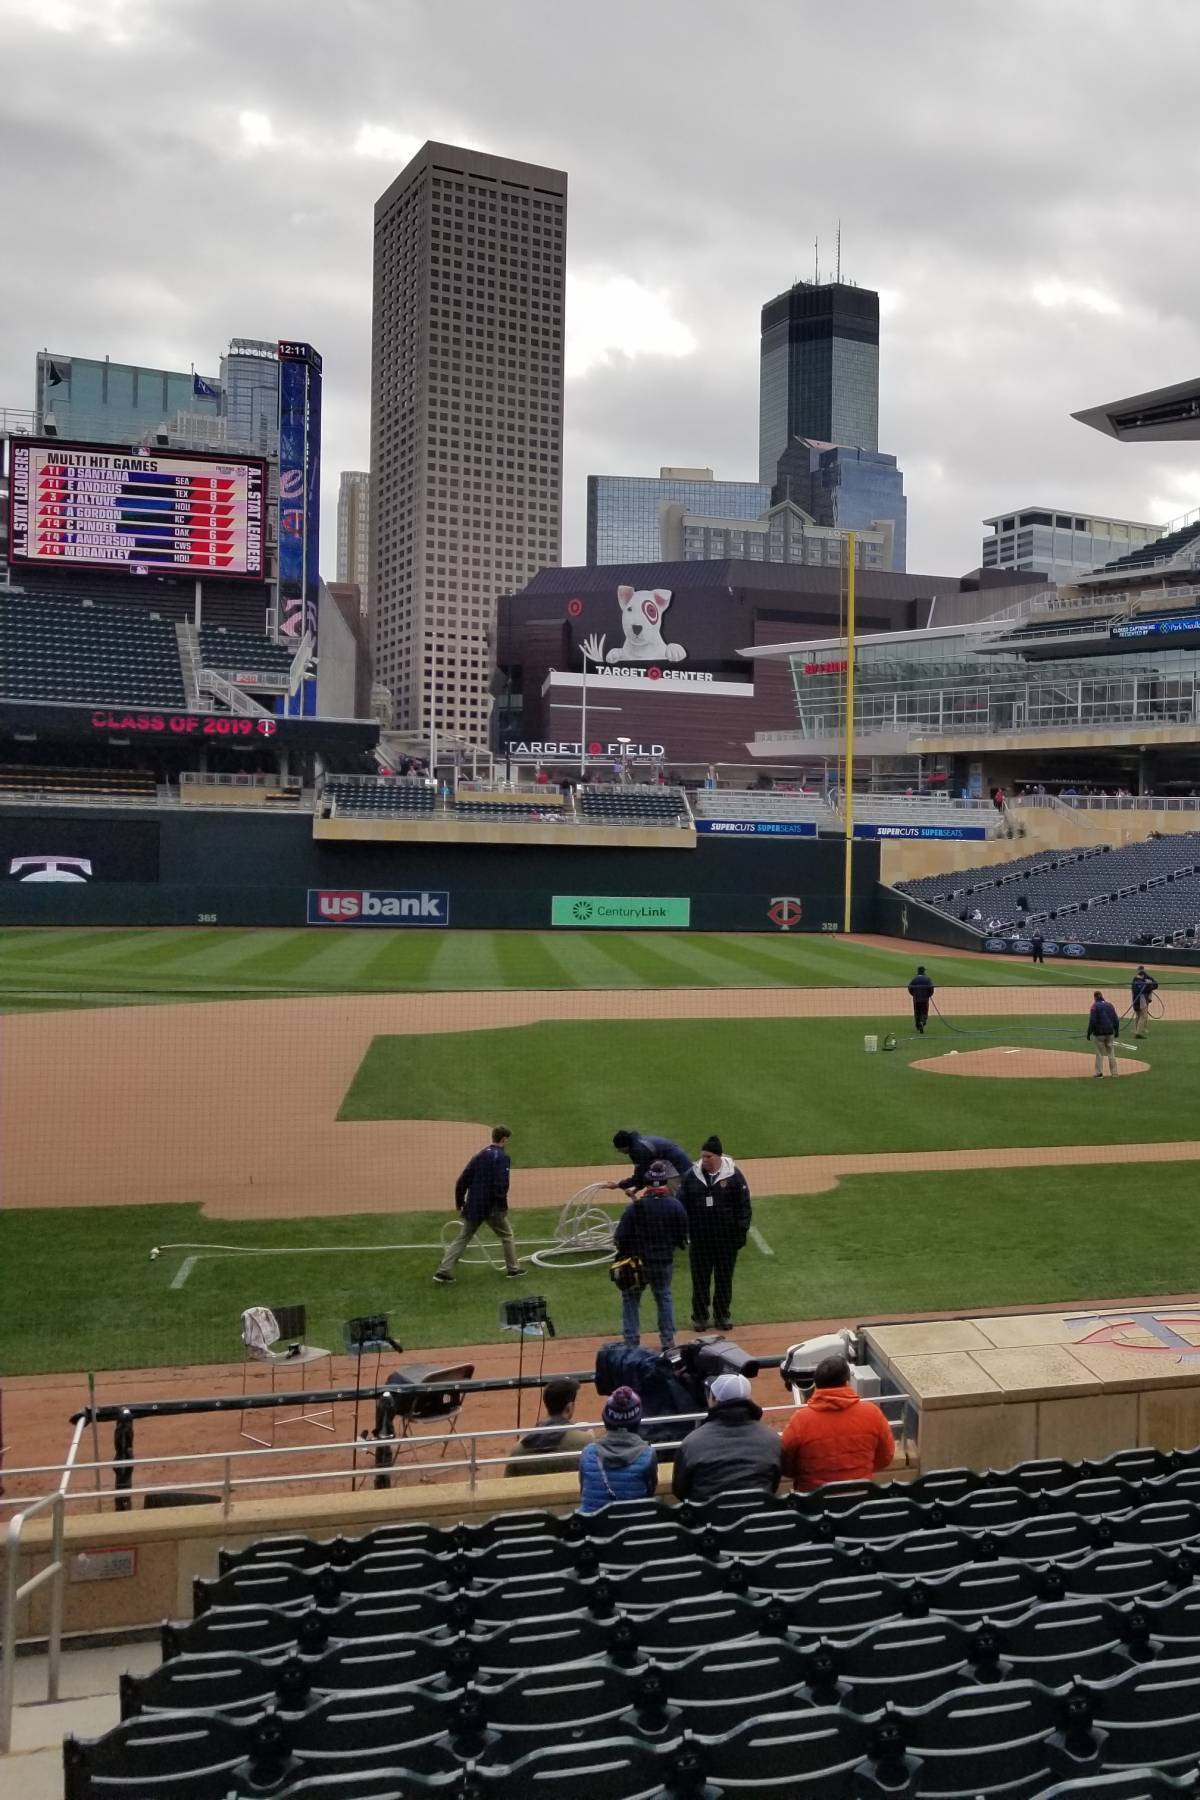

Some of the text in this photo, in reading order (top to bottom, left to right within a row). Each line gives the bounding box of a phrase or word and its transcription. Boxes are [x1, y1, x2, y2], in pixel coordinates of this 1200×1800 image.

[280, 344, 305, 356] 12:11
[48, 453, 158, 472] MULTI HIT GAMES
[15, 448, 28, 501] LEADERS
[68, 468, 75, 477] D
[78, 469, 129, 482] SANTANA
[176, 477, 190, 486] SEA
[68, 482, 74, 490] E
[76, 482, 122, 494] ANDRUS
[175, 490, 188, 498] TEX
[210, 492, 217, 501] 8
[50, 492, 216, 514] 3 J ALTUVE HOU 7
[248, 492, 261, 519] STAT
[14, 503, 28, 531] STAT
[46, 506, 60, 514] T4
[66, 508, 74, 516] A
[76, 508, 121, 520] GORDON
[210, 518, 217, 526] 6
[46, 519, 216, 540] T4 C PINDER OAK 6
[46, 532, 216, 553] T4 T ANDERSON CWS 6
[248, 521, 260, 571] LEADERS
[46, 545, 59, 554] T4
[65, 547, 75, 556] M
[76, 547, 130, 560] BRANTLEY
[209, 556, 216, 565] 6
[596, 666, 713, 682] TARGET CENTER
[91, 711, 253, 735] CLASS OF 2019
[508, 742, 665, 756] TARGET FIELD
[711, 823, 802, 833] SUPERCUTS SUPERSEATS
[877, 828, 919, 836] SUPERCUTS
[197, 914, 216, 922] 365
[597, 905, 666, 918] CenturyLink
